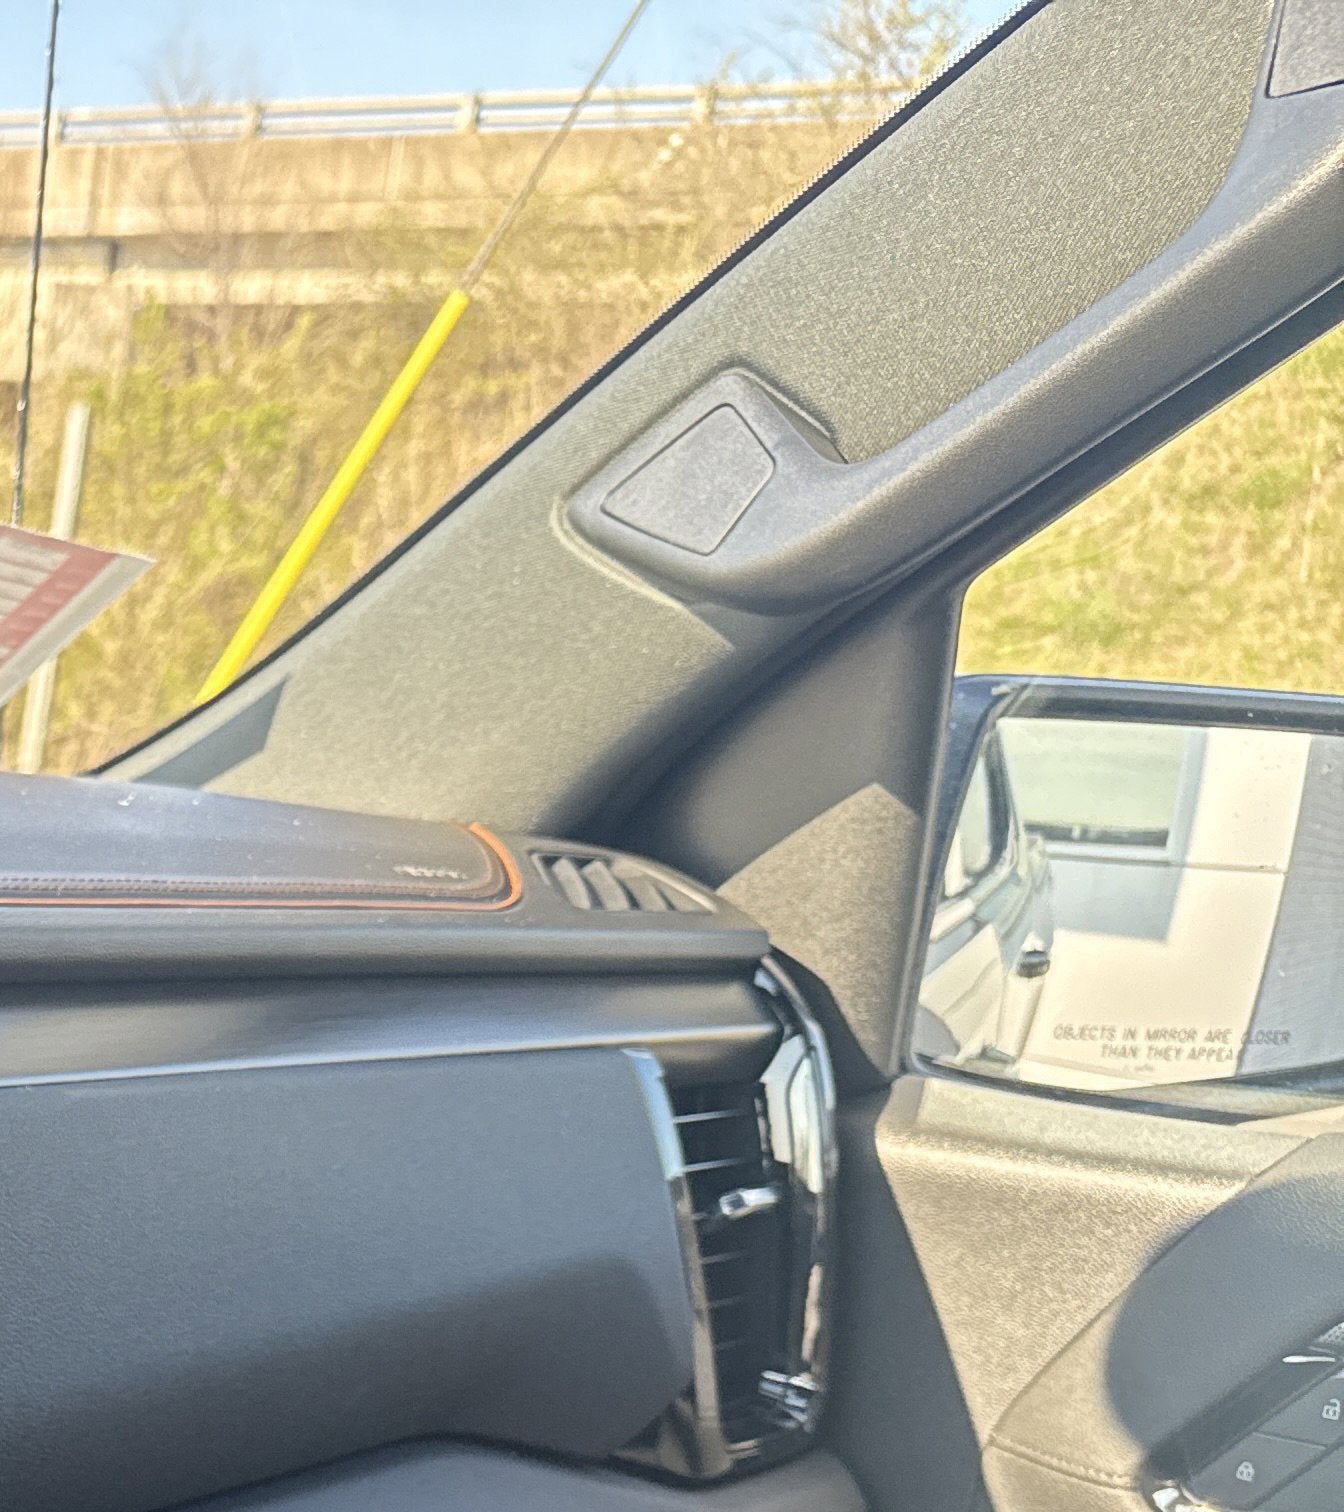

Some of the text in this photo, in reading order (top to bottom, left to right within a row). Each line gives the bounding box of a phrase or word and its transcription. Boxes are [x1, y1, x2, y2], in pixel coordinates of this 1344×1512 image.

[1053, 1024, 1292, 1046] OBJECTS IN MIRROR ARE CLOSER
[1100, 1044, 1242, 1063] THAN THEY APPEA
